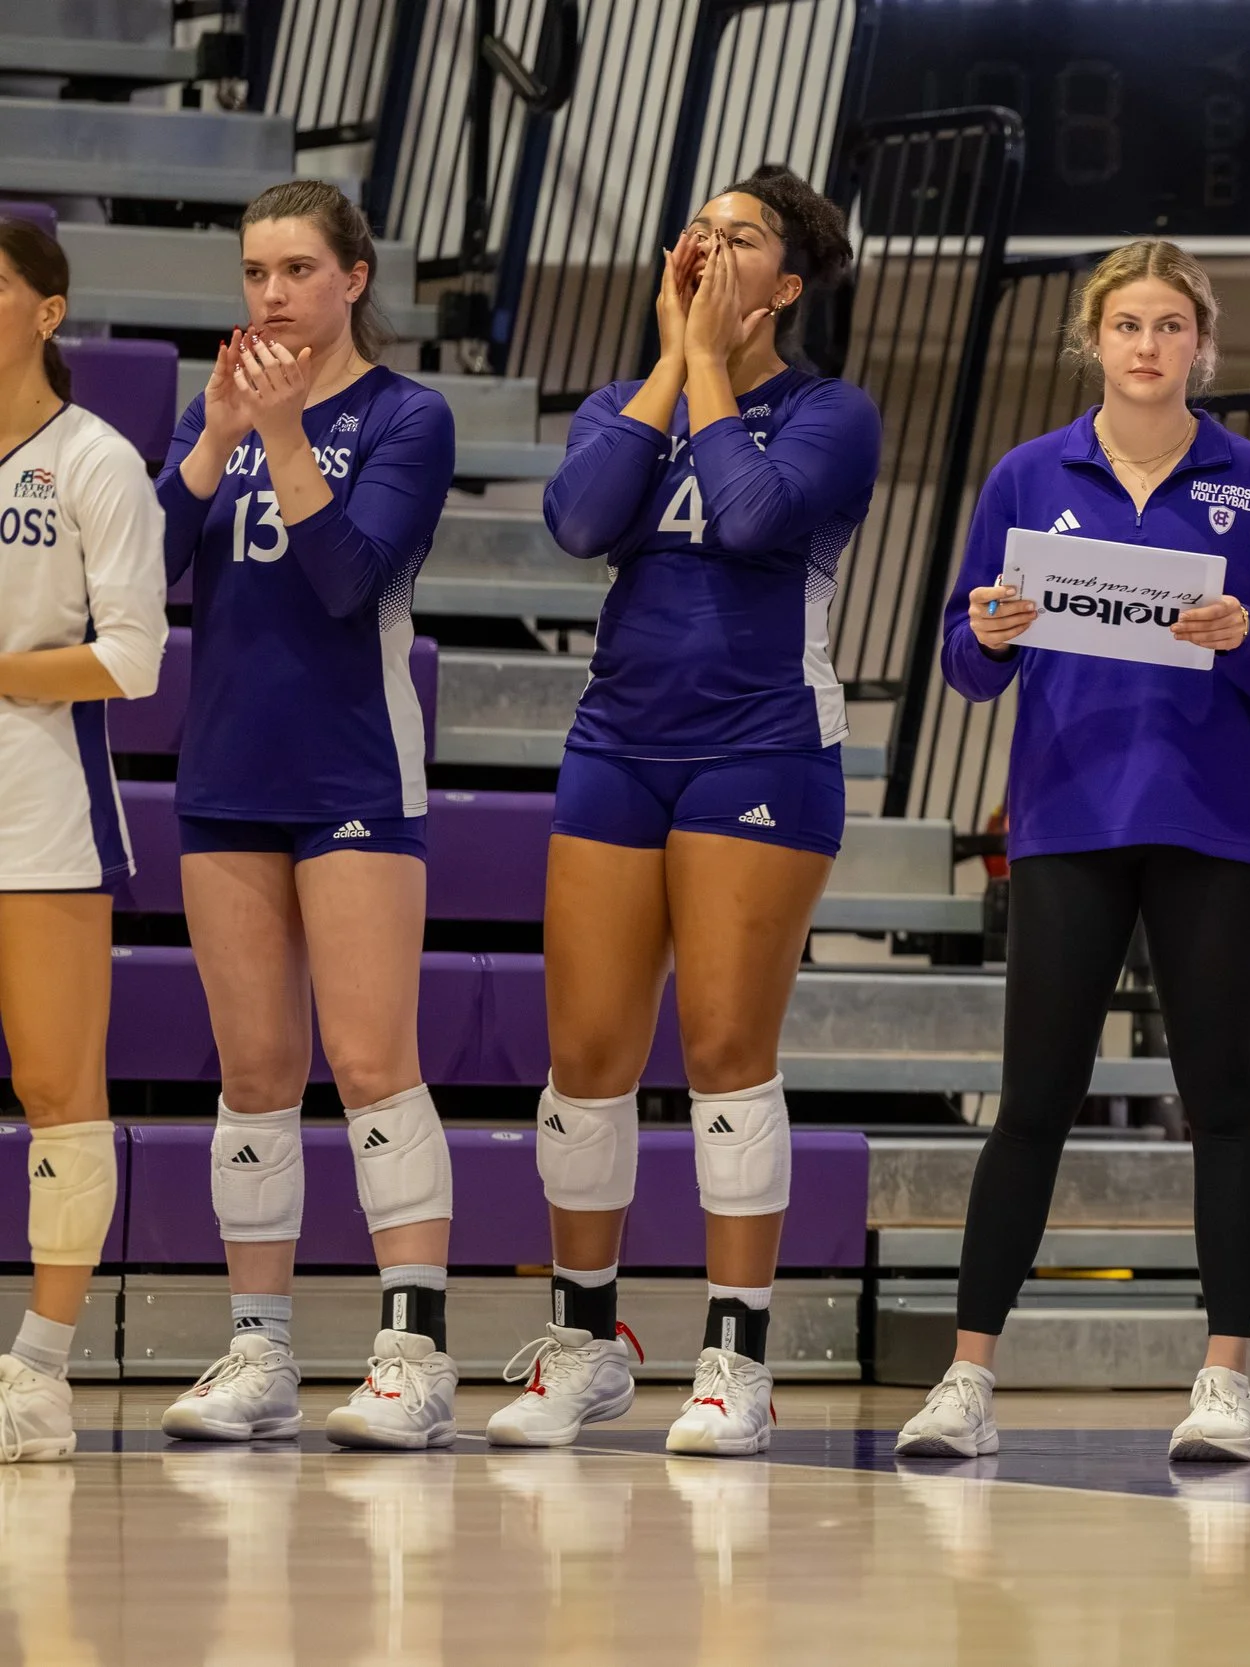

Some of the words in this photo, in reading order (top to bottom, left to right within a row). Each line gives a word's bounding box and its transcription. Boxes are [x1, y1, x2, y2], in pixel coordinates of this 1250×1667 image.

[225, 444, 266, 476] OLY
[1192, 480, 1221, 494] HOLY
[657, 475, 708, 544] 4
[0, 507, 57, 547] OSS
[233, 490, 289, 563] 13
[1045, 574, 1098, 588] game
[1096, 582, 1138, 593] real
[1141, 587, 1171, 601] the
[1172, 592, 1204, 605] For
[738, 815, 776, 827] adidas
[333, 829, 371, 839] adidas
